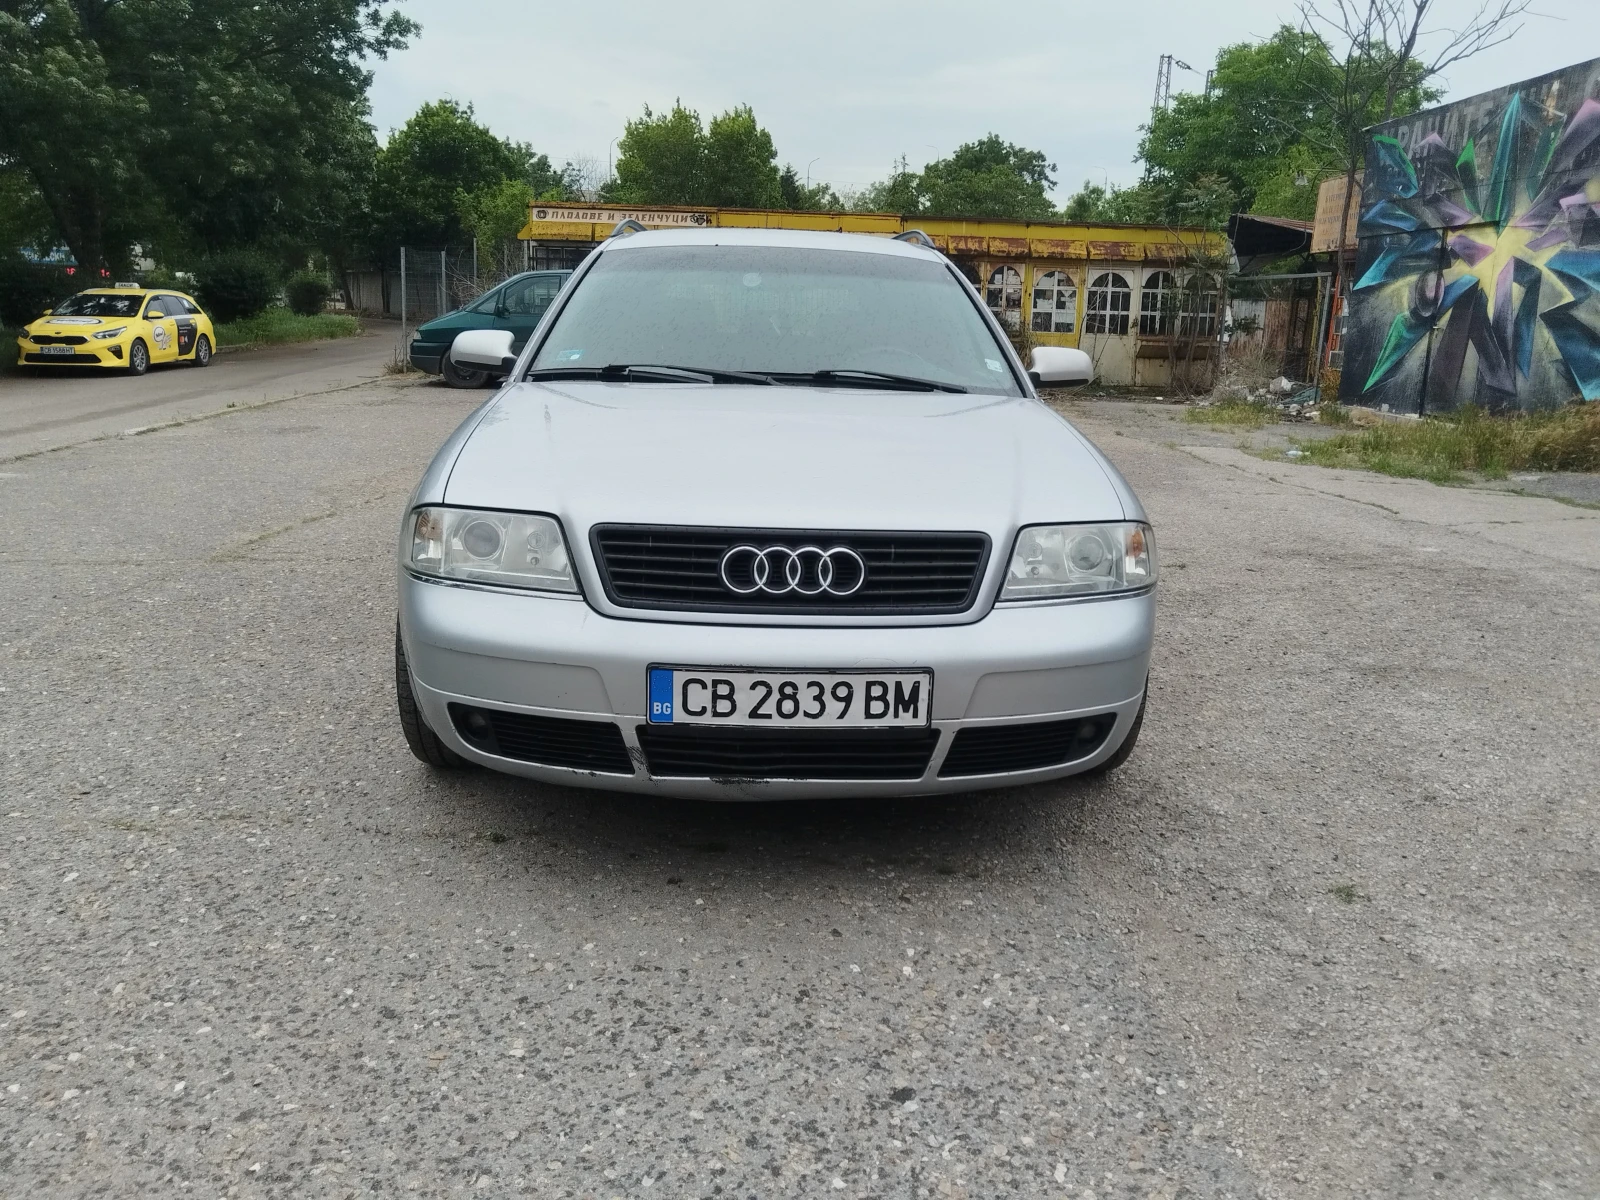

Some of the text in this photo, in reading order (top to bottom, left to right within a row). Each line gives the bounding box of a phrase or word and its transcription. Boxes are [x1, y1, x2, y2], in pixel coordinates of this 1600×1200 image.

[551, 211, 603, 221] ПЛОДОВЕ
[607, 213, 615, 221] И
[681, 678, 921, 719] CB 2839 BM
[653, 702, 672, 714] BG
